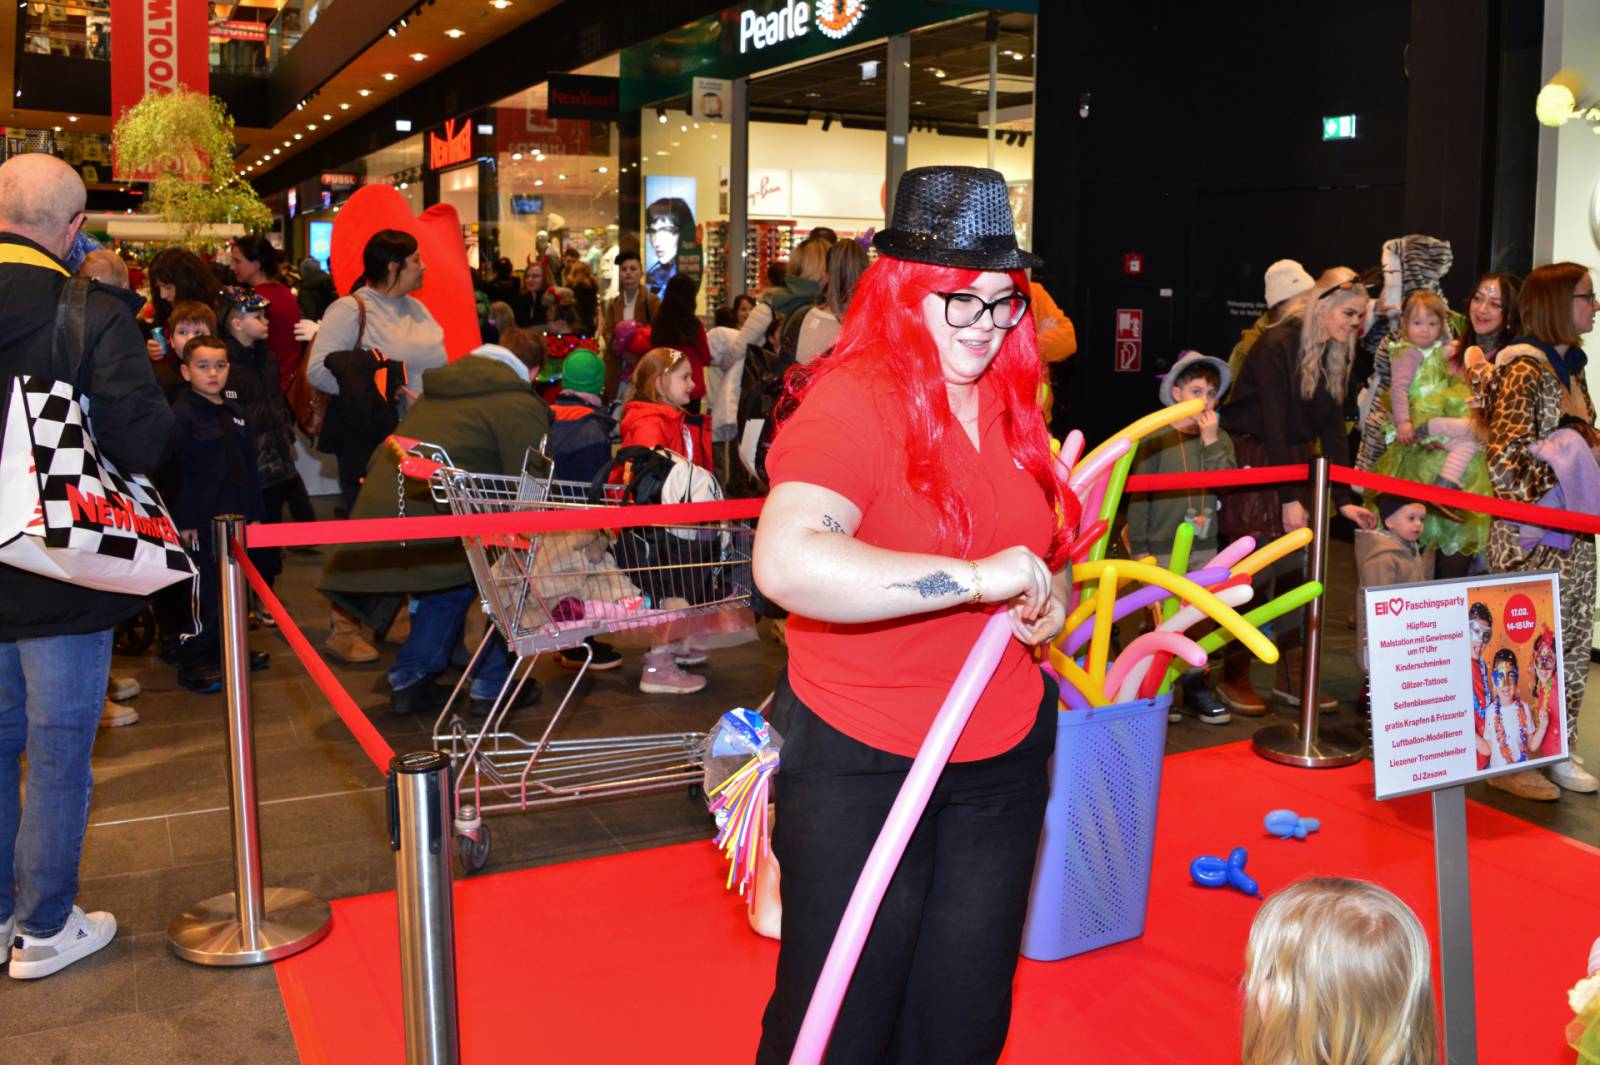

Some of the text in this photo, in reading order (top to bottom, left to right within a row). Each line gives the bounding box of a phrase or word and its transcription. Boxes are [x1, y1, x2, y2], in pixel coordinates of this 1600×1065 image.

[740, 0, 810, 53] Pearle
[1375, 596, 1464, 615] Eli Faschingsparty
[1511, 608, 1529, 617] 17.02.
[1406, 621, 1437, 631] Hüpfburg
[1523, 620, 1535, 629] Uhr
[1380, 630, 1464, 648] Malstation mit Gewinnspiel
[1426, 645, 1438, 653] Uhr
[1395, 658, 1451, 672] Kinderschminken
[1402, 677, 1448, 690] Glitzer-Tattoos
[1393, 693, 1457, 710] Seifenblasenzauber
[1384, 721, 1404, 732] gratis
[1404, 716, 1430, 727] Krapfen
[1430, 714, 1435, 722] &
[1391, 730, 1463, 748] Luftballon-Modellieren
[1389, 747, 1467, 768] Liezener Trommelweiber
[1412, 769, 1448, 782] DJ Zesawa
